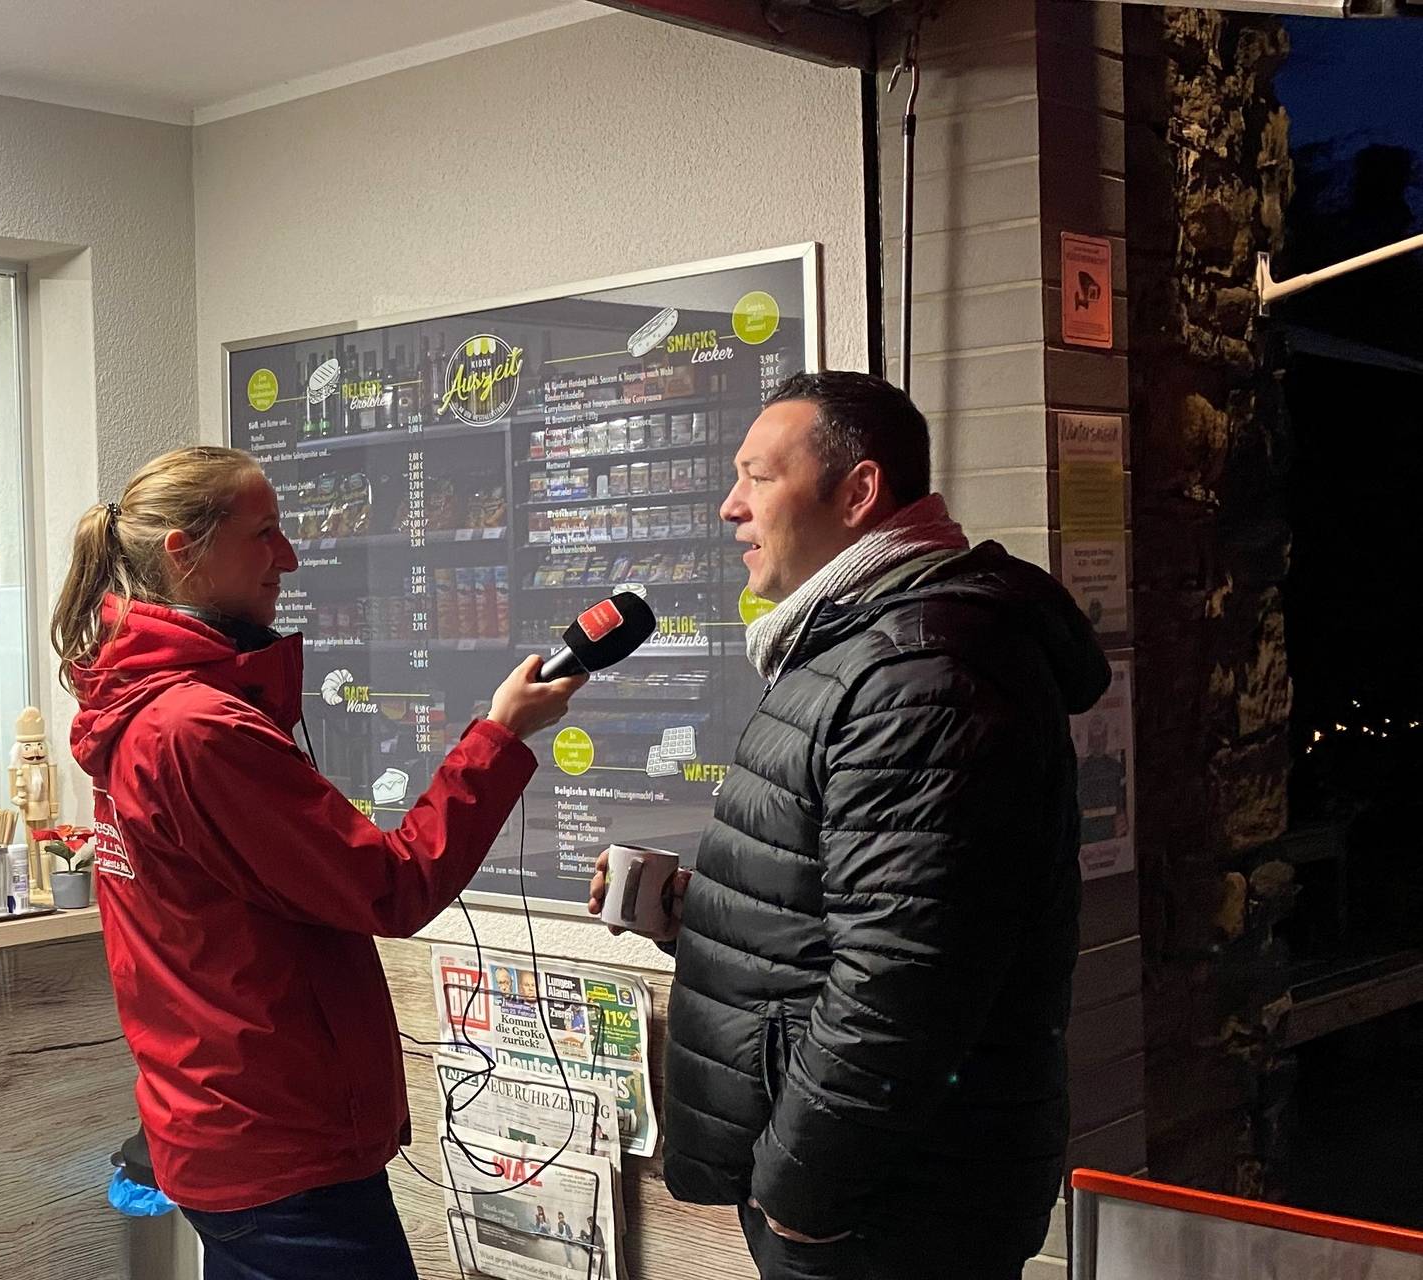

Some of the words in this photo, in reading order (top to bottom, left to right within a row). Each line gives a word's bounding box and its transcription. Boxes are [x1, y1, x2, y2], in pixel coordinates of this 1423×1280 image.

[667, 329, 717, 353] SNACKS
[691, 345, 734, 364] Lecker
[759, 354, 774, 365] 3,90
[471, 358, 492, 368] KIOSK
[760, 366, 775, 378] 2,80
[437, 347, 523, 415] Auszeit
[761, 379, 775, 390] 3,30
[650, 631, 709, 646] Getränke
[344, 686, 369, 701] BACK
[346, 701, 378, 714] Waren
[554, 786, 588, 797] Belgische
[588, 788, 613, 797] Waffel
[547, 975, 575, 989] Lungen-
[548, 986, 569, 999] Alarm
[501, 1014, 538, 1028] Kommt
[604, 1010, 632, 1027] 11%
[496, 1024, 510, 1033] die
[512, 1026, 545, 1040] GroKo
[502, 1036, 540, 1048] zurück?
[484, 1077, 515, 1097] NEUE
[515, 1085, 551, 1106] RUHR
[552, 1092, 610, 1119] ZEITUNG
[492, 1155, 543, 1188] WAZ
